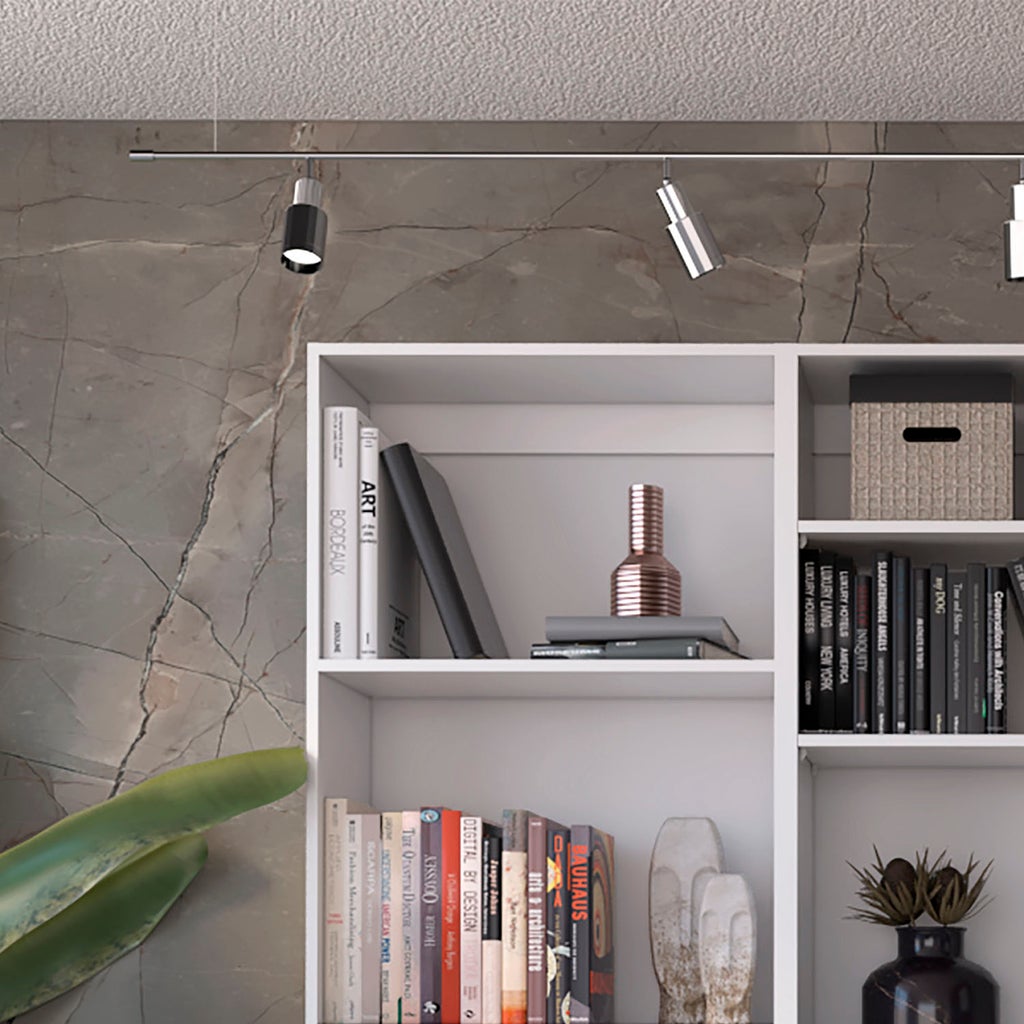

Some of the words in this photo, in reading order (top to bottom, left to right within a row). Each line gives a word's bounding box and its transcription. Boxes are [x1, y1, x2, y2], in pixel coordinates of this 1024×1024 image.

[361, 480, 376, 517] ART
[330, 508, 346, 574] BORDEAUX
[804, 562, 815, 596] LUXURY
[820, 566, 832, 599] LUXURY
[840, 571, 849, 603] LUXURY
[804, 598, 815, 634] HOUSES
[820, 600, 832, 628] LIVING
[935, 592, 945, 614] DOG
[994, 590, 1003, 648] Conversations
[840, 604, 849, 638] HOTELS
[878, 624, 887, 651] ANGELS
[820, 646, 832, 666] NEW
[840, 648, 849, 684] AMERICA
[855, 628, 868, 672] INIQUITY
[994, 650, 1003, 668] with
[820, 667, 832, 691] YORK
[994, 669, 1003, 710] Architects
[464, 819, 477, 863] DIGITAL
[367, 841, 376, 895] SCARPA
[422, 854, 439, 904] ODYSSEY
[464, 870, 477, 883] BY
[489, 860, 499, 888] Jasper
[528, 872, 545, 892] arts
[572, 845, 588, 921] BAUHAUS
[464, 891, 477, 932] DESIGN
[490, 890, 499, 915] Johns
[382, 938, 390, 963] POWER
[528, 909, 545, 971] architecture
